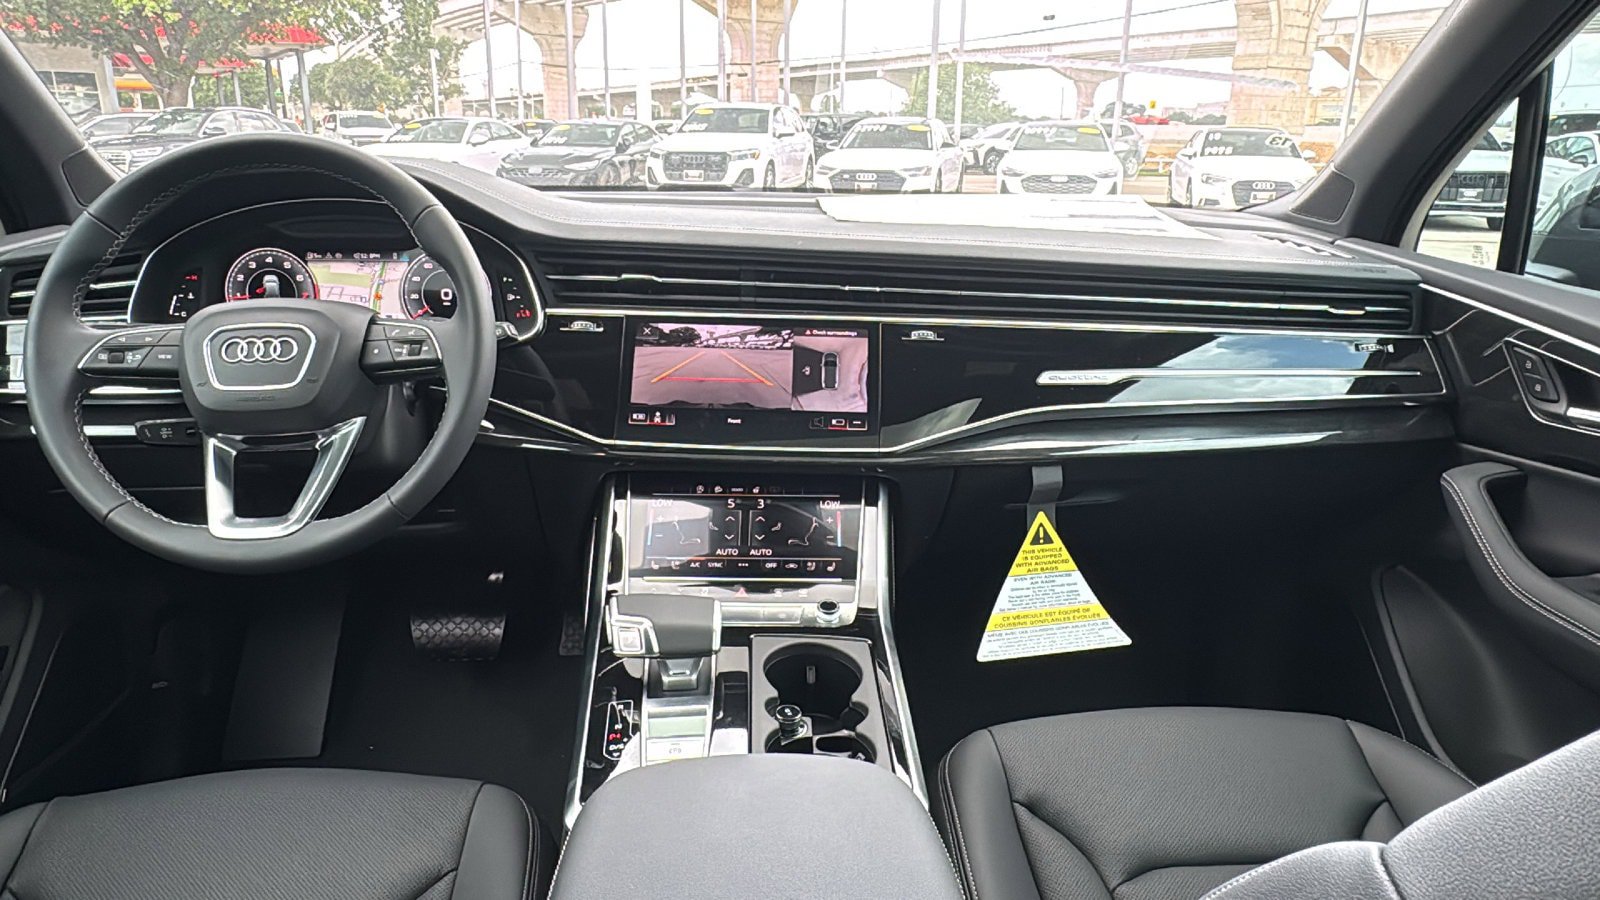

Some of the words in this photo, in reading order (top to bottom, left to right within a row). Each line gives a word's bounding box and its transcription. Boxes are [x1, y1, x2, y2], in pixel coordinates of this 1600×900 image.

[248, 261, 257, 269] 3
[283, 261, 292, 269] 5
[440, 288, 452, 300] 0
[652, 499, 674, 508] LOW
[728, 498, 736, 508] 5
[757, 498, 765, 508] 3
[820, 500, 840, 509] LOW
